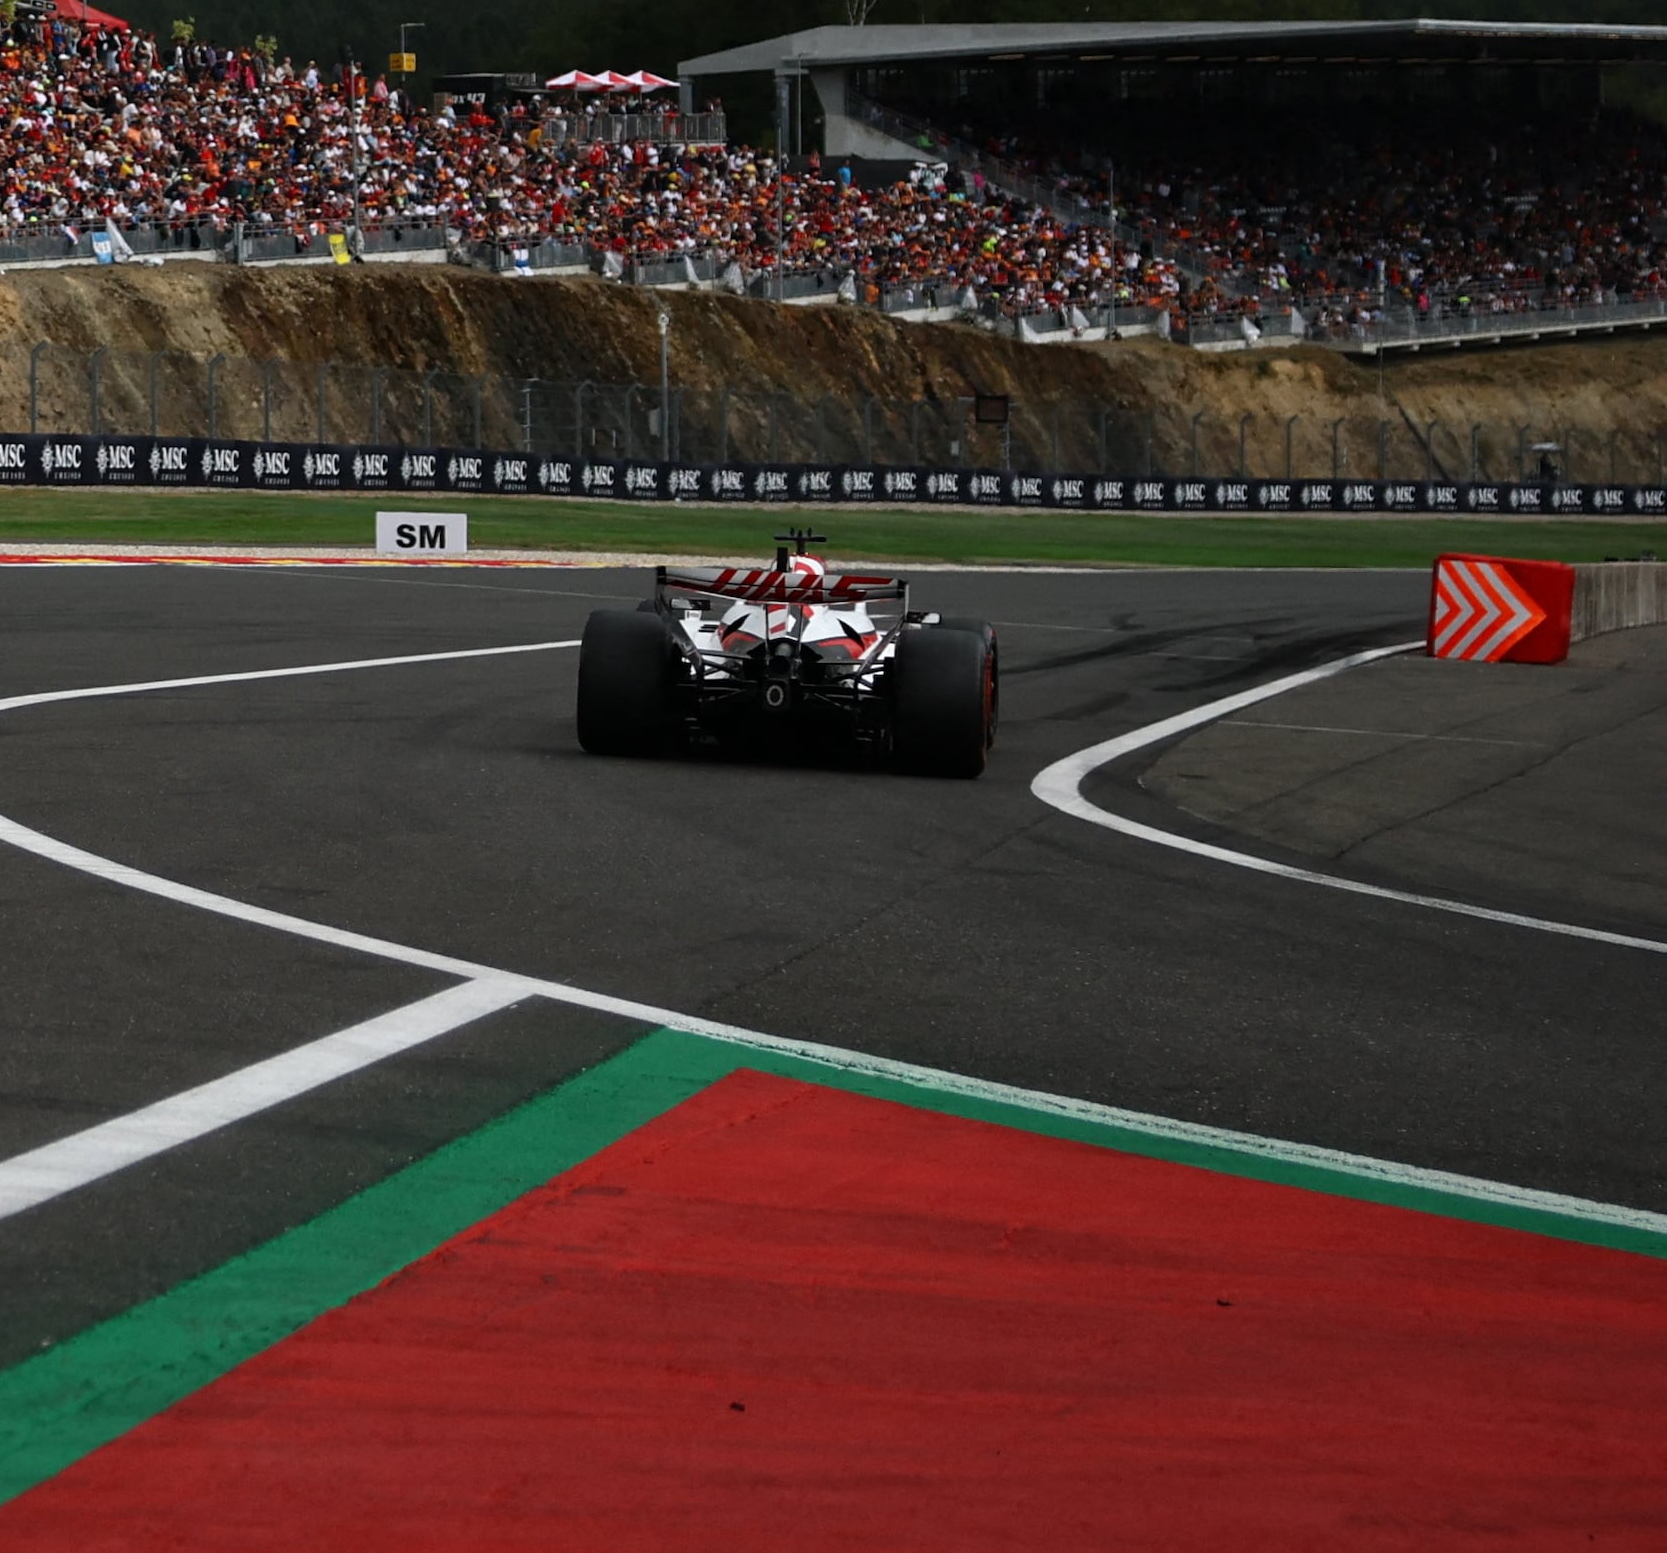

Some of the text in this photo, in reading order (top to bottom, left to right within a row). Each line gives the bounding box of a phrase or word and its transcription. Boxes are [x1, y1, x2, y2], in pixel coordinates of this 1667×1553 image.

[55, 445, 81, 468] MSC
[109, 446, 135, 468] MSC
[161, 447, 187, 469] MSC
[214, 449, 239, 471] MSC
[265, 453, 290, 475] MSC
[315, 453, 340, 476] MSC
[365, 454, 388, 476] MSC
[413, 455, 436, 477] MSC
[459, 458, 482, 479] MSC
[505, 461, 527, 481] MSC
[395, 523, 446, 549] SM
[708, 568, 893, 604] HAAS
